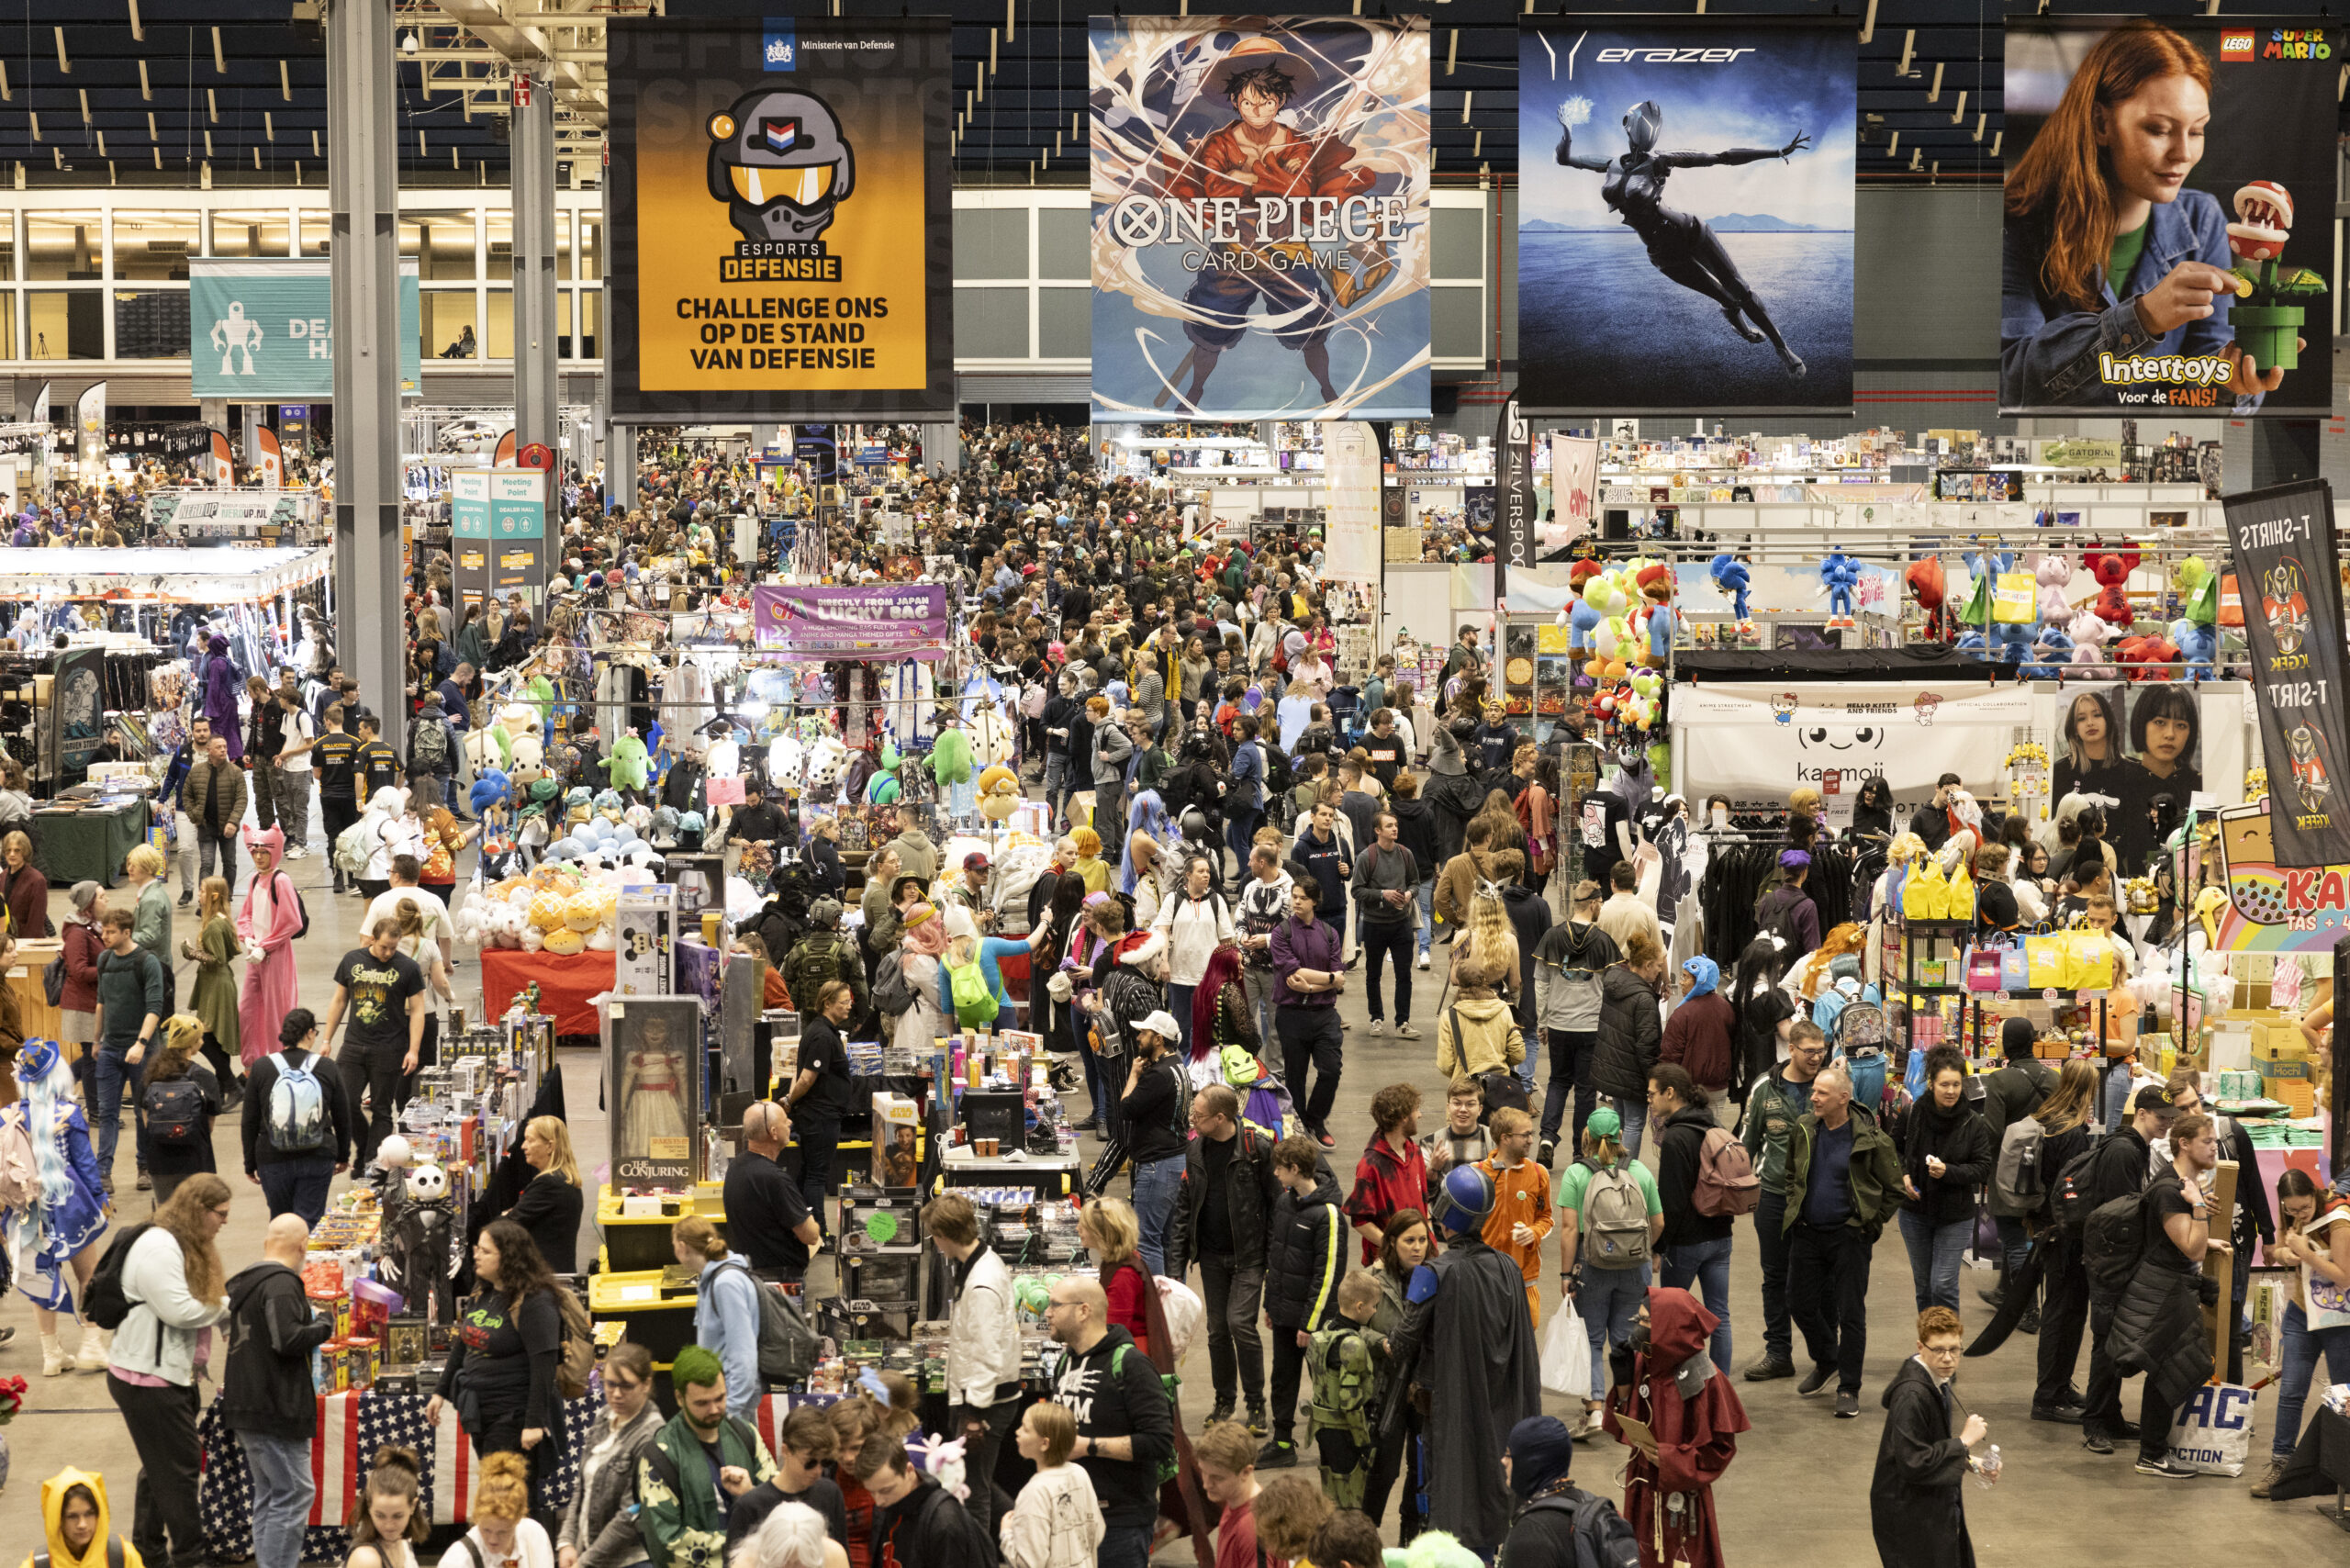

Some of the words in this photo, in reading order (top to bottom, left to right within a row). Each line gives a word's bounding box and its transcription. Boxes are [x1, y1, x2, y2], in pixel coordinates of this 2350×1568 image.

[2271, 28, 2324, 43] SUPER
[801, 40, 842, 50] Ministerie
[860, 40, 894, 50] Defensie
[2222, 36, 2254, 52] LEGO
[2263, 40, 2332, 61] MARIO
[1596, 48, 1756, 63] erazer
[1113, 194, 1241, 247] ONE
[1255, 195, 1408, 244] PIECE
[742, 243, 819, 256] ESPORTS
[1182, 250, 1257, 272] CARD
[1270, 250, 1350, 271] GAME
[725, 259, 836, 280] DEFENSIE
[677, 297, 829, 319] CHALLENGE
[835, 297, 889, 318] ONS
[700, 324, 735, 344] OP
[742, 324, 775, 343] DE
[780, 323, 865, 344] STAND
[690, 349, 743, 369] VAN
[750, 348, 875, 369] DEFENSIE
[2100, 352, 2233, 386] Intertoys
[2118, 391, 2148, 405] Voor
[2151, 390, 2166, 404] de
[2169, 388, 2218, 407] FANS!
[2069, 449, 2115, 457] GATOR.NL
[461, 478, 481, 487] Meeting
[221, 509, 267, 519] NERDUP.NL
[818, 598, 861, 607] DIRECTLY
[865, 598, 894, 606] FROM
[897, 597, 929, 606] JAPAN
[818, 606, 884, 621] LUCKY
[890, 605, 929, 620] BAG
[1371, 750, 1395, 760] MARVEL
[1797, 762, 1883, 781] kamoji
[2287, 870, 2350, 911] KA
[2286, 915, 2318, 931] TAS
[2274, 1067, 2300, 1076] Mochi
[620, 1163, 688, 1179] CONJURING
[2172, 1449, 2223, 1463] CTION
